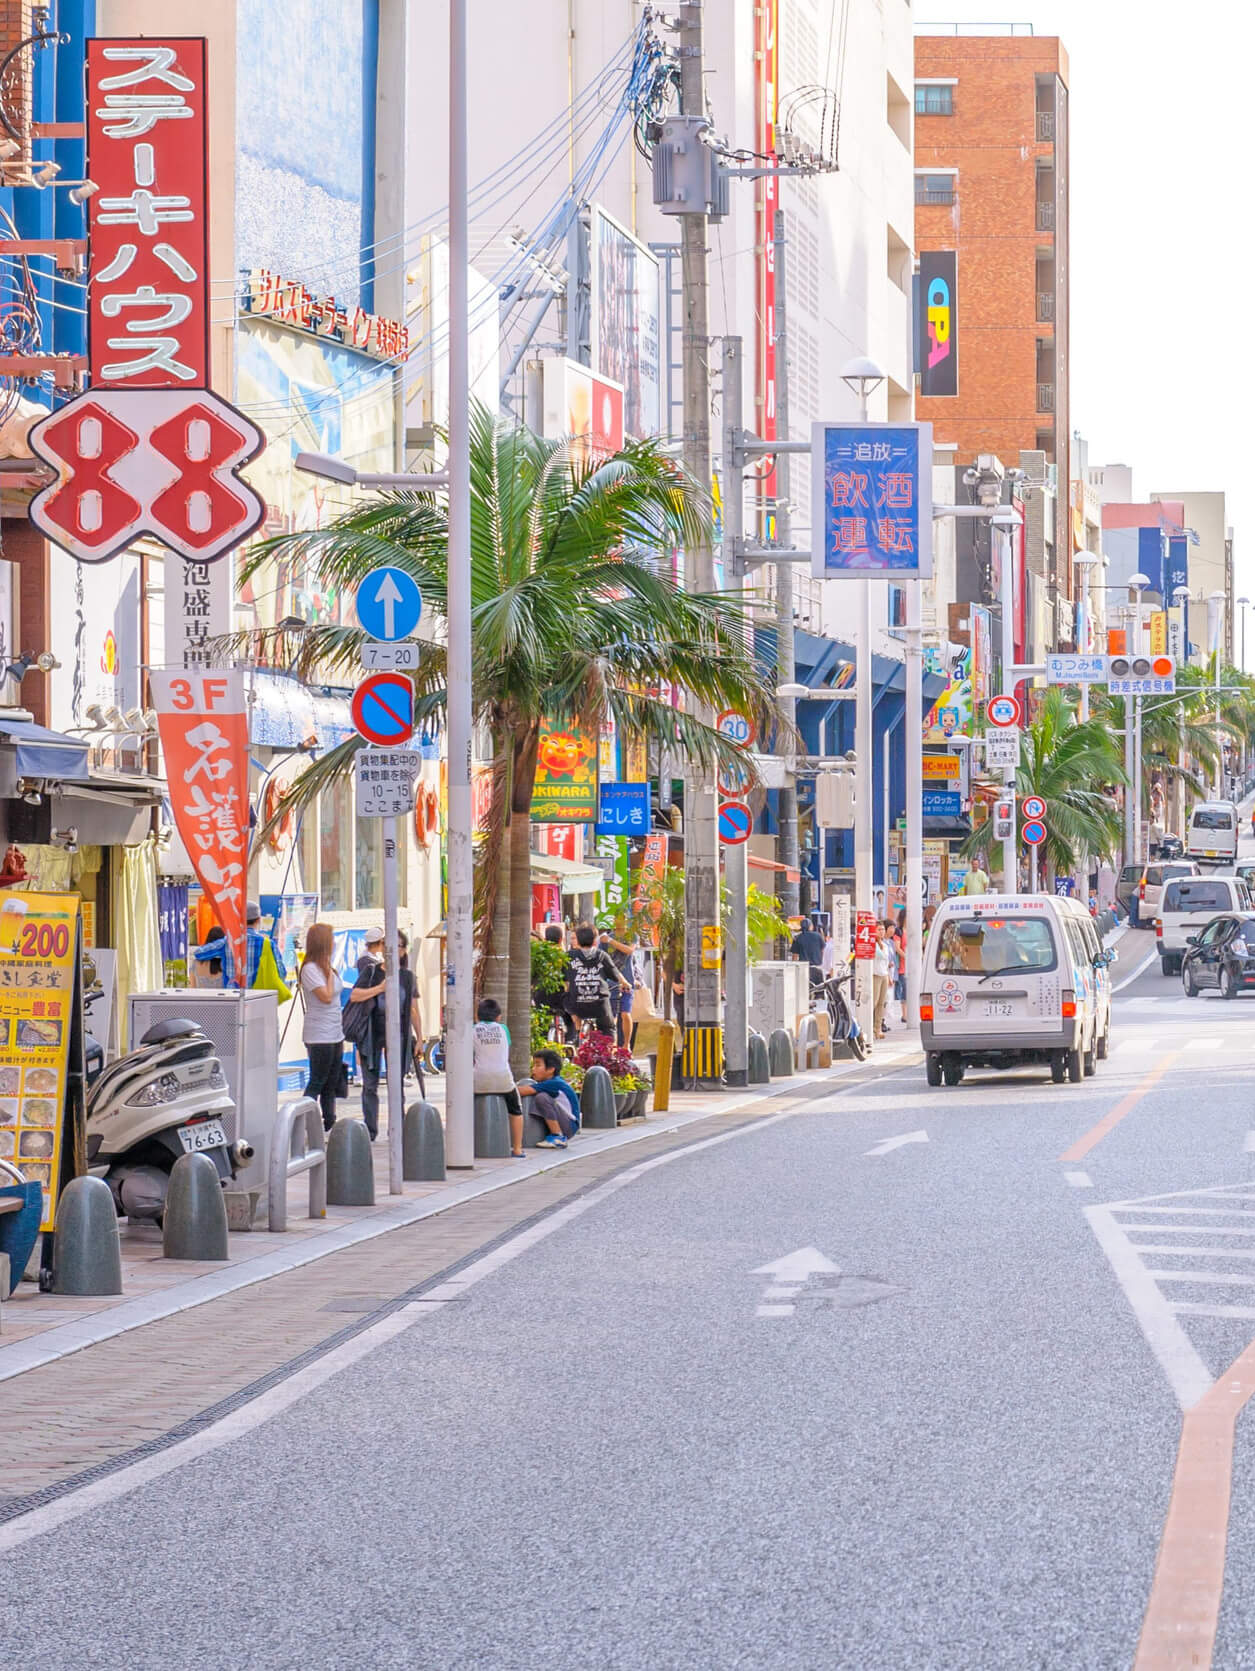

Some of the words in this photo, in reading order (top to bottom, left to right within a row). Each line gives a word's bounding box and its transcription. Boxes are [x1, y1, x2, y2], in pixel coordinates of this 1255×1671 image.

[97, 47, 197, 380] ステーキハウス
[927, 277, 951, 369] OPA
[42, 402, 247, 547] 88
[831, 472, 914, 508] 飲酒
[831, 516, 914, 552] 運転
[1051, 659, 1103, 671] むつみ橋
[168, 679, 228, 710] 3F
[724, 720, 748, 739] 30
[360, 754, 417, 766] 貨物集配中の
[360, 769, 416, 782] 貨物車を除く
[184, 1130, 224, 1150] 76-63
